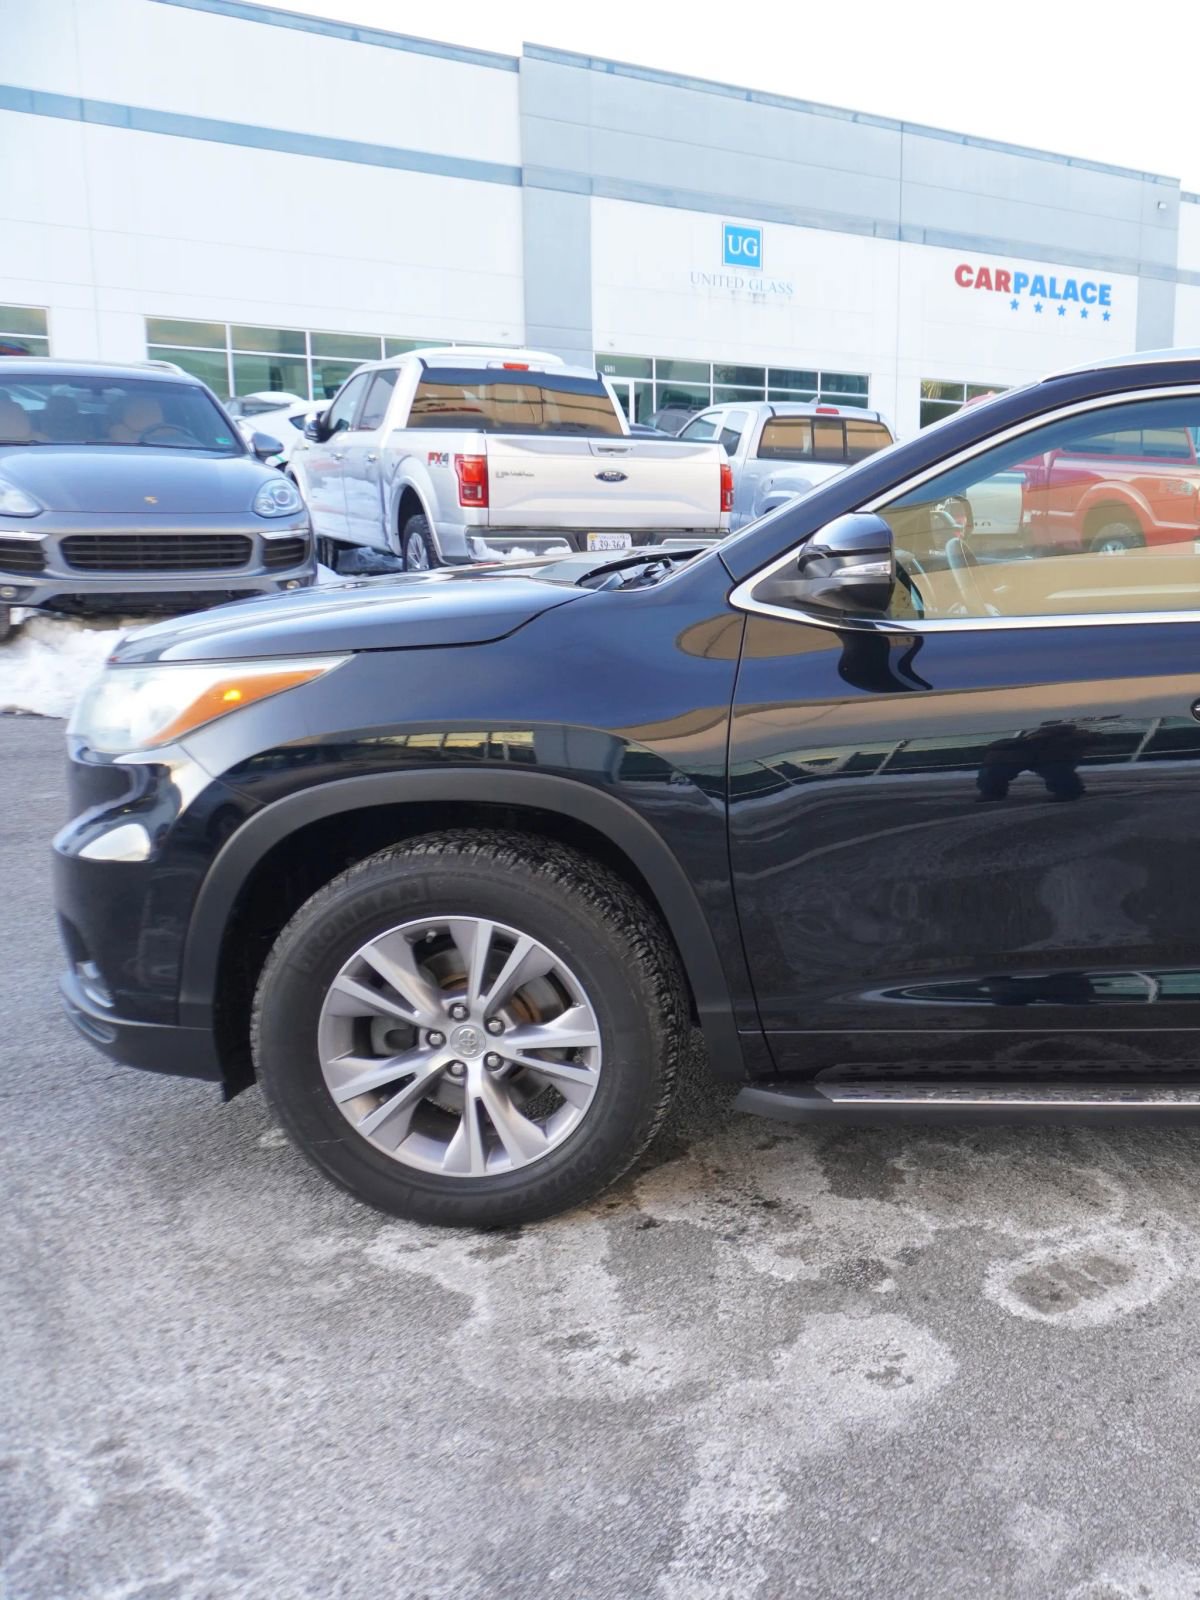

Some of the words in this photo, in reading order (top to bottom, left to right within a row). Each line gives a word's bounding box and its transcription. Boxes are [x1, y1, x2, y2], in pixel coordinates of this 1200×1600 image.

[727, 234, 759, 257] UG
[690, 271, 745, 289] UNITED
[748, 279, 794, 295] GLASS
